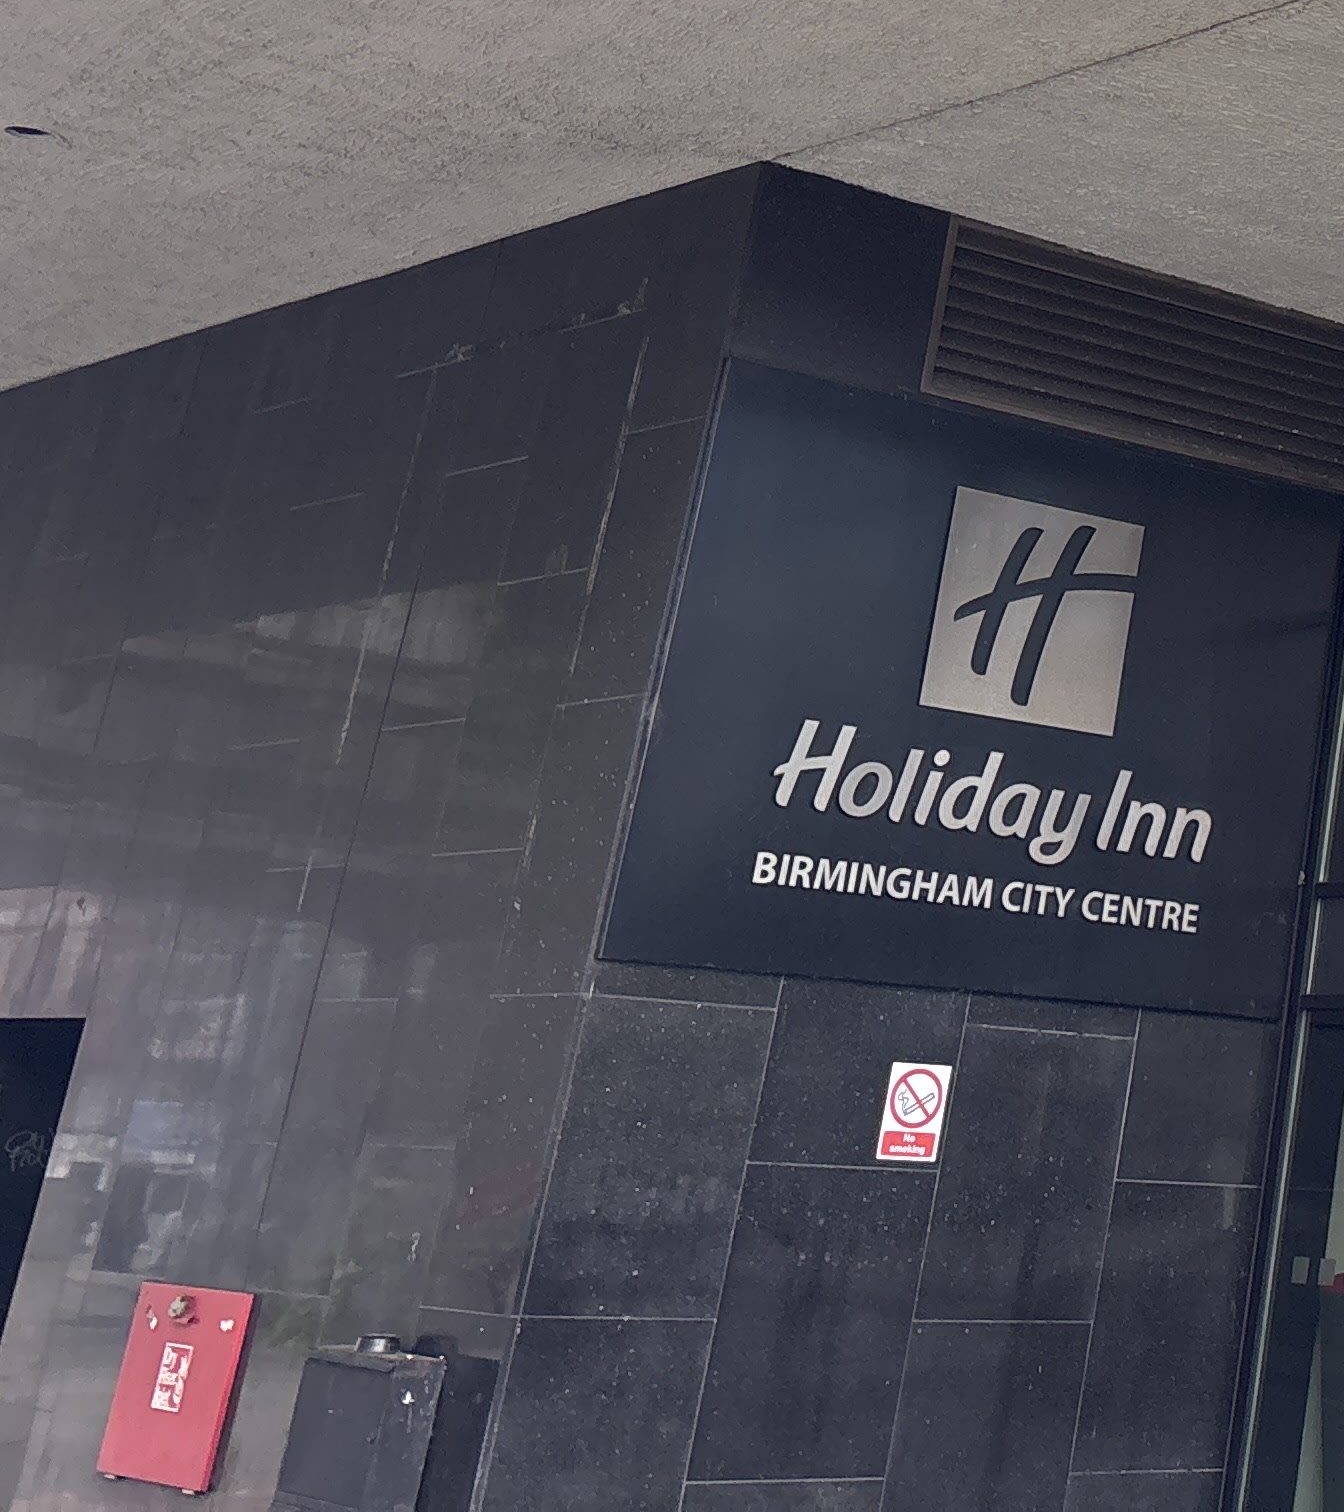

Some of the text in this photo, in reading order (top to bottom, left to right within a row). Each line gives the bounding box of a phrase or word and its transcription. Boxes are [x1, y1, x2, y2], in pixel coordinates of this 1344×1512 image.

[773, 719, 1212, 865] Holiday Inn
[752, 851, 1199, 934] BIRMINGHAM CITY CENTRE
